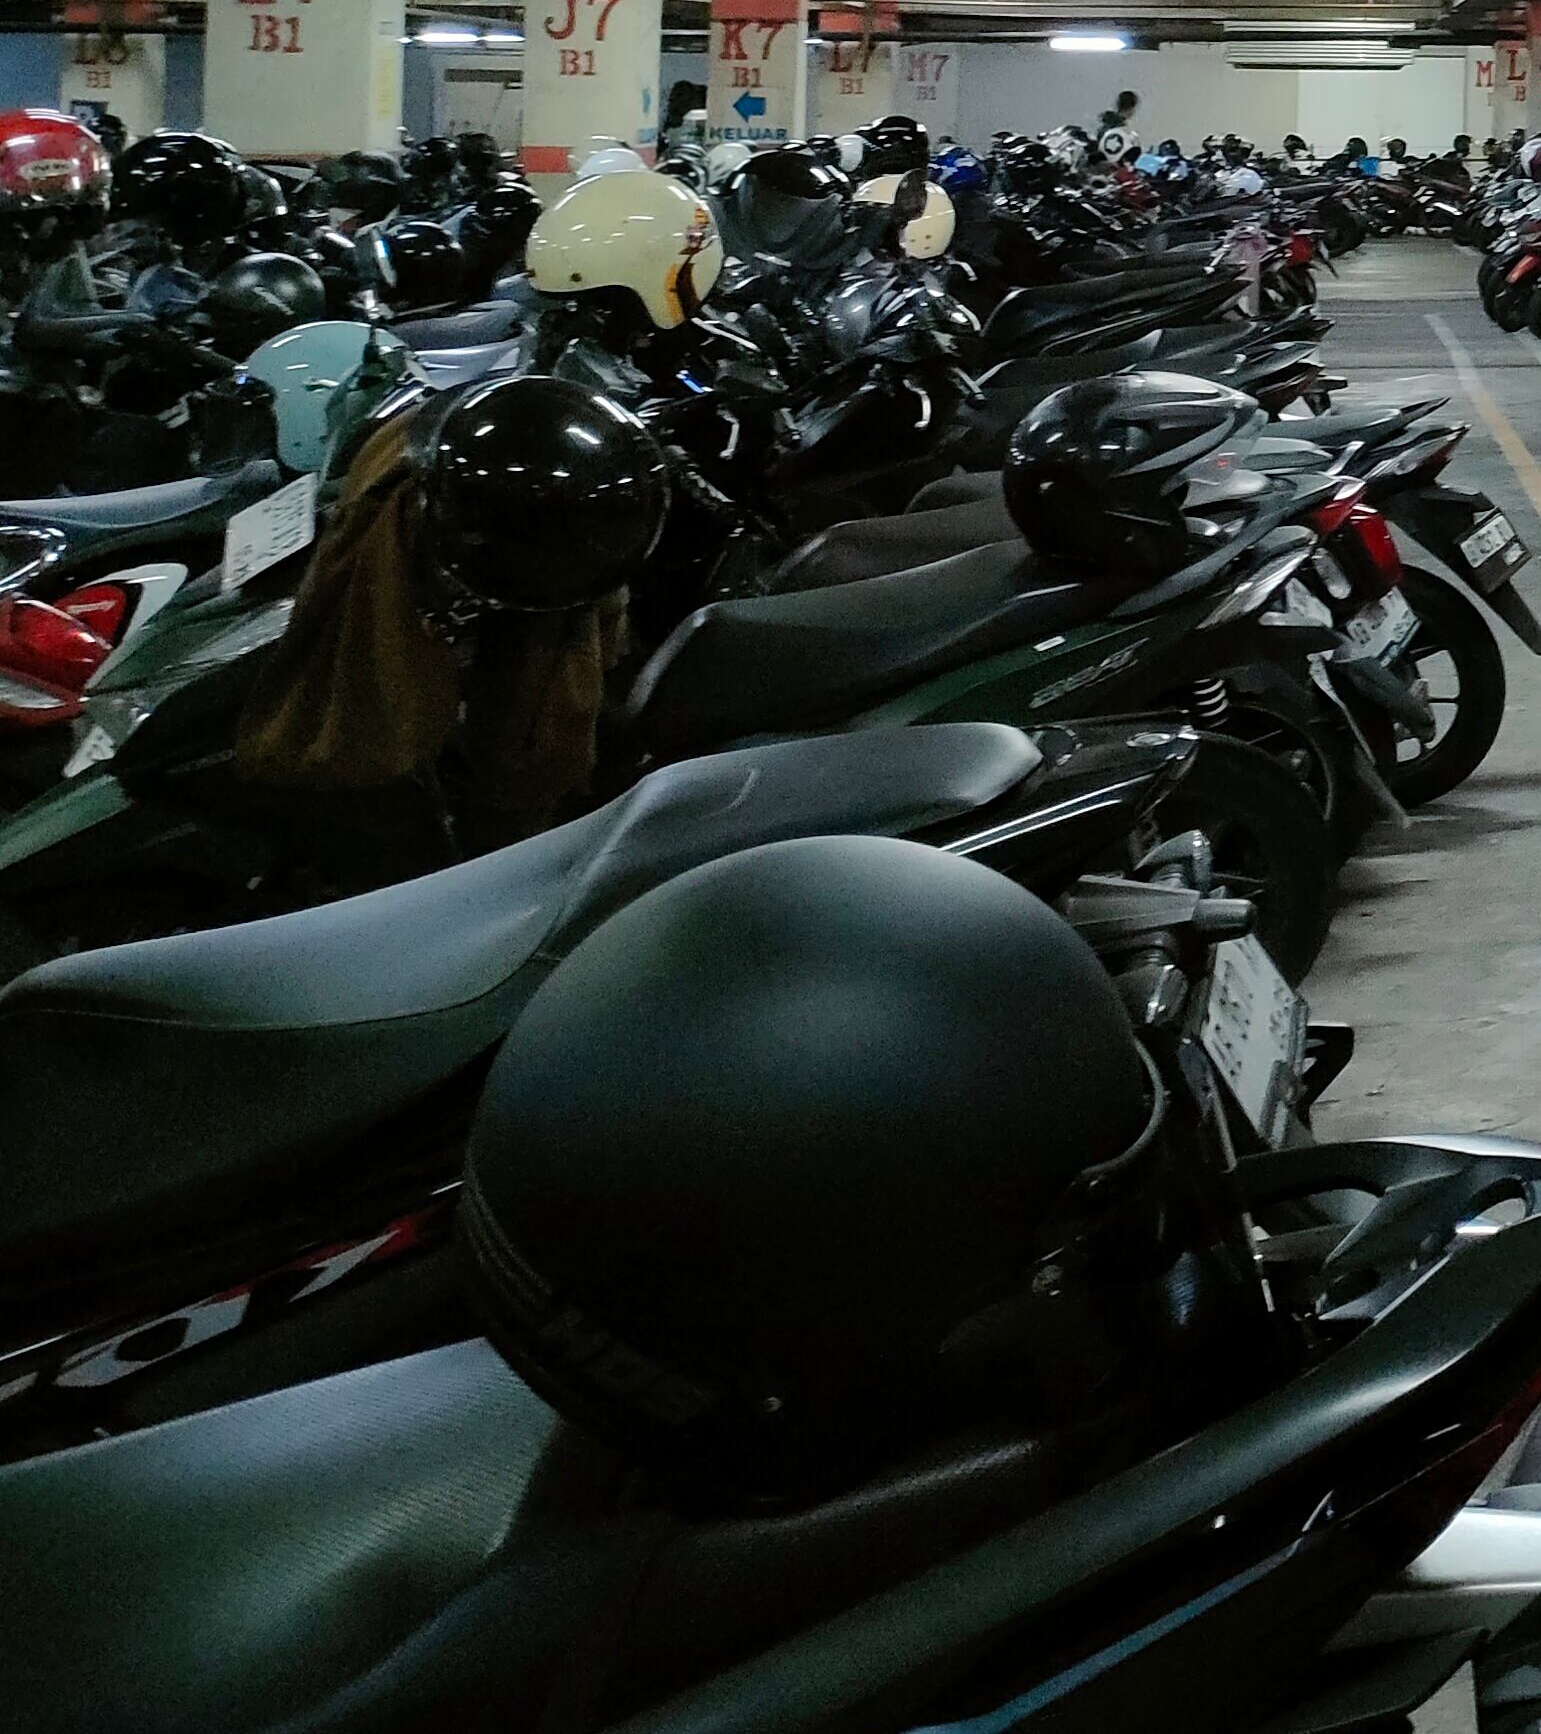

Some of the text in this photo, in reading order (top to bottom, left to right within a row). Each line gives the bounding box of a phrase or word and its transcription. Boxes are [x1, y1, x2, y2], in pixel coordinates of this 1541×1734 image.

[247, 14, 305, 55] B1
[718, 18, 785, 61] K7
[558, 49, 597, 78] B1
[731, 67, 763, 88] B1
[708, 126, 789, 141] KELUAR
